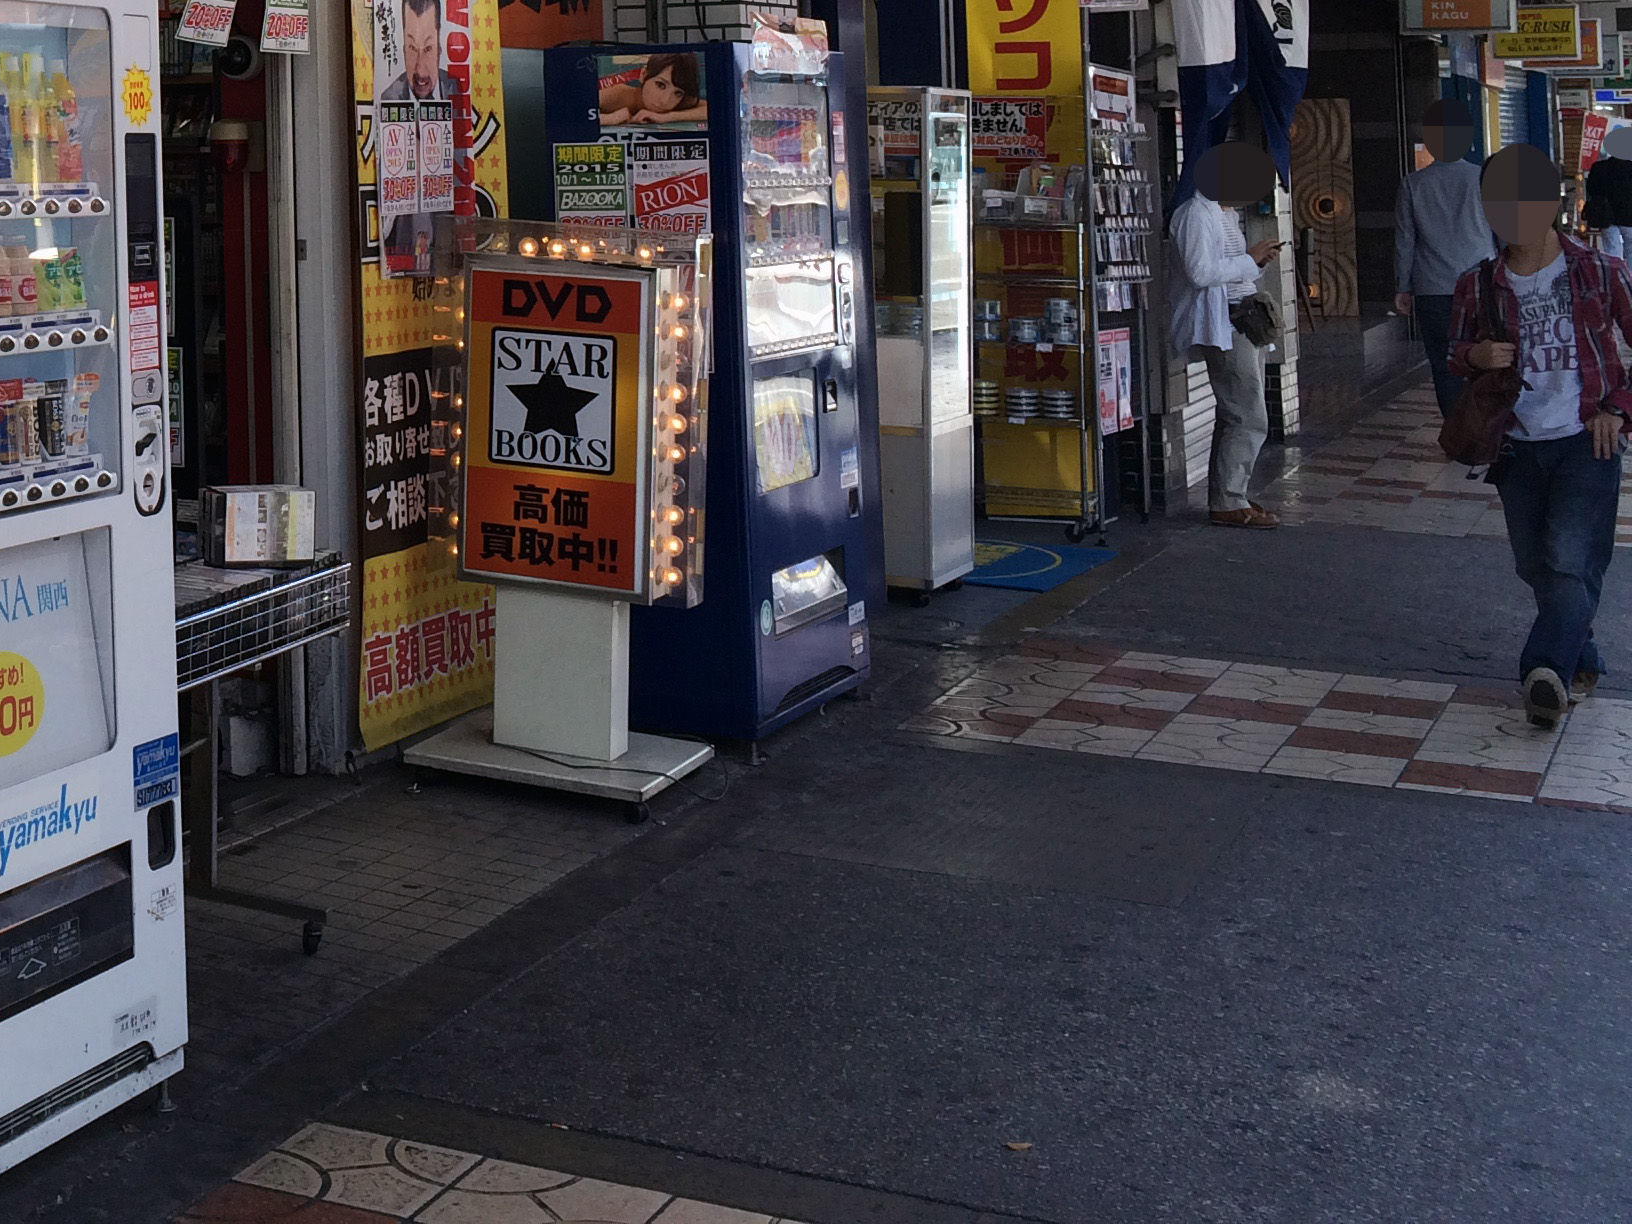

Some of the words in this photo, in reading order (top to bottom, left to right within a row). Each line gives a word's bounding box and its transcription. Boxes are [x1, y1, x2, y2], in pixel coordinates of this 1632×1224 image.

[1431, 11, 1470, 20] KAGU
[556, 144, 624, 163] 期間限定
[635, 144, 706, 163] 期間限定
[556, 174, 579, 186] 10/1
[596, 174, 626, 186] 11/30
[558, 163, 621, 174] 2015
[560, 191, 624, 210] BAZOOKA
[639, 177, 700, 213] RION
[638, 213, 706, 234] 30%OFF
[502, 278, 613, 324] DVD
[496, 334, 611, 380] STAR
[494, 428, 609, 469] BOOKS
[512, 483, 590, 529] 高価
[479, 522, 620, 575] 買取中!!
[37, 578, 70, 615] 関西
[364, 598, 496, 702] 高額買取中
[31, 800, 60, 818] SERVICE
